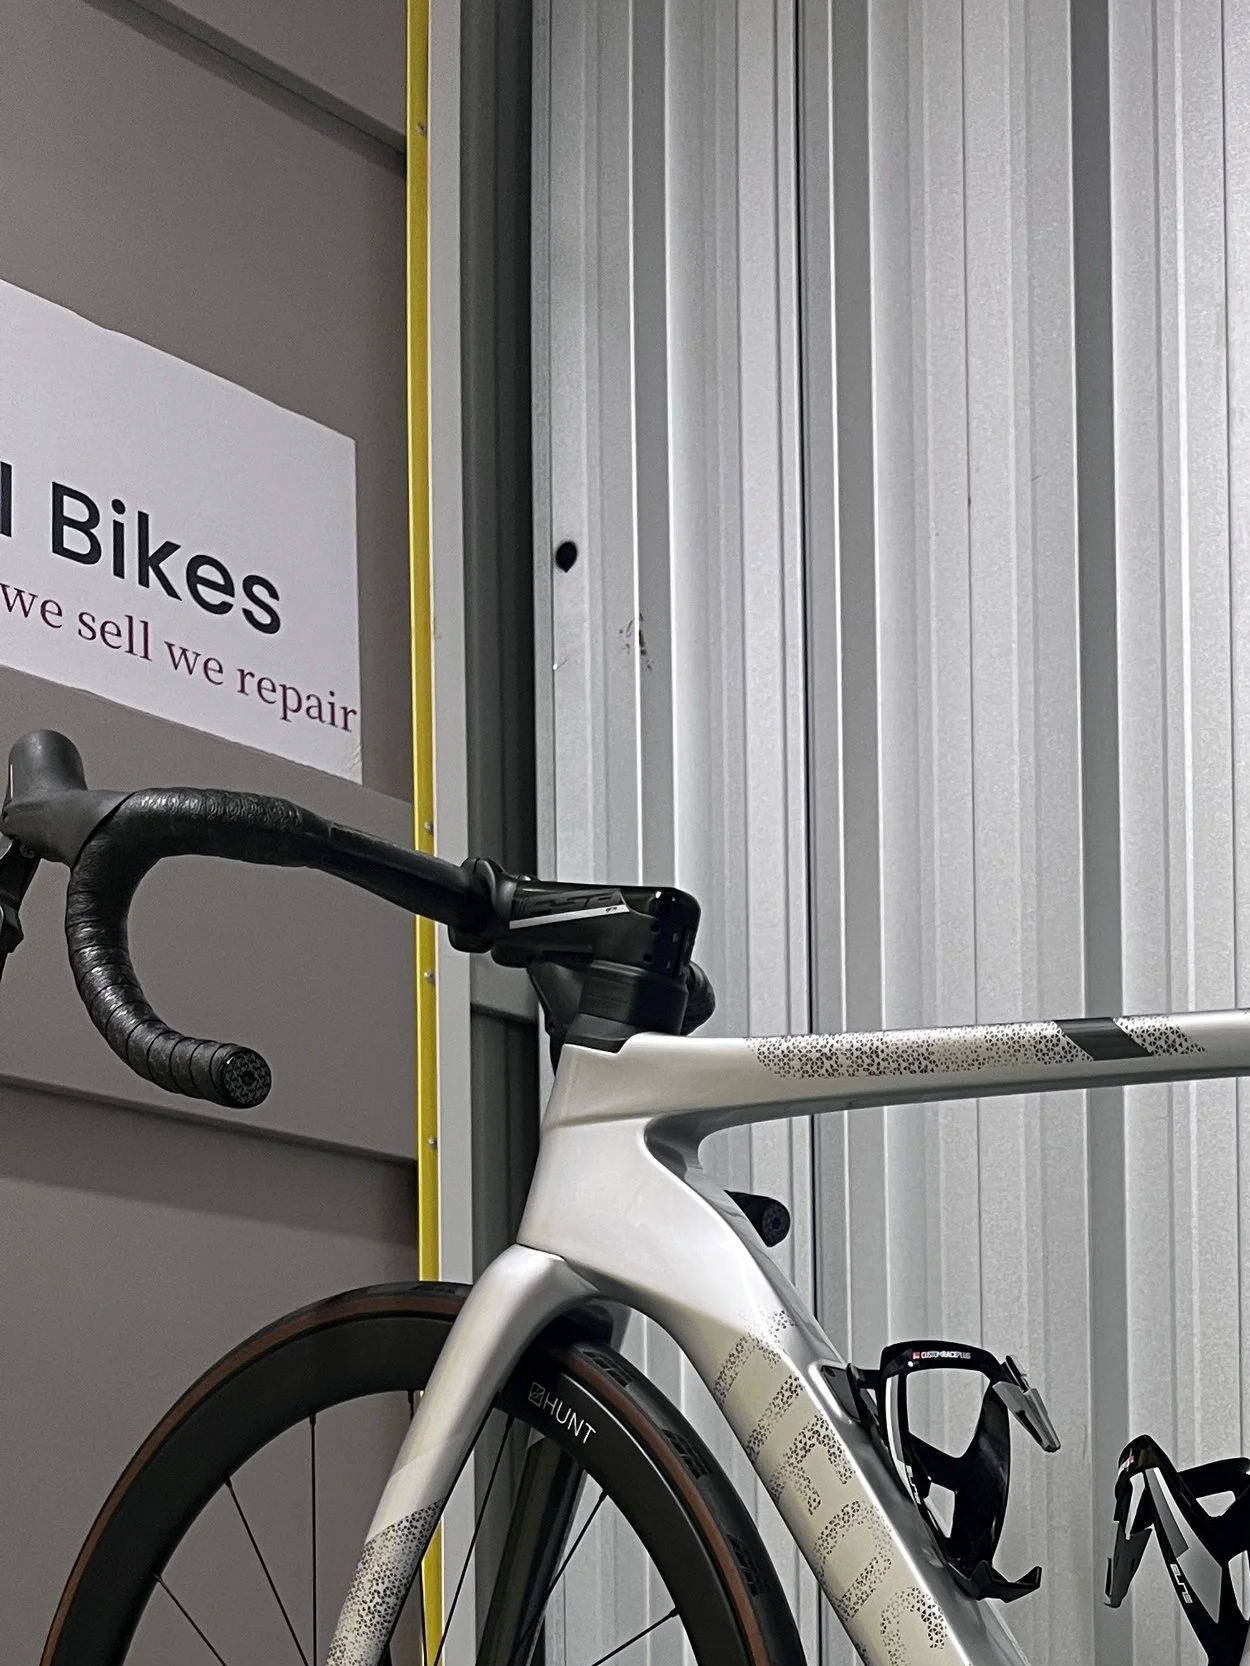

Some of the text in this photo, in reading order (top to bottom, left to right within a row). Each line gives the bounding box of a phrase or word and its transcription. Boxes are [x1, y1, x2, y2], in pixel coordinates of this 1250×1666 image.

[52, 481, 282, 635] Bikes
[0, 582, 358, 733] we sell we repair
[542, 1391, 597, 1444] HUNT
